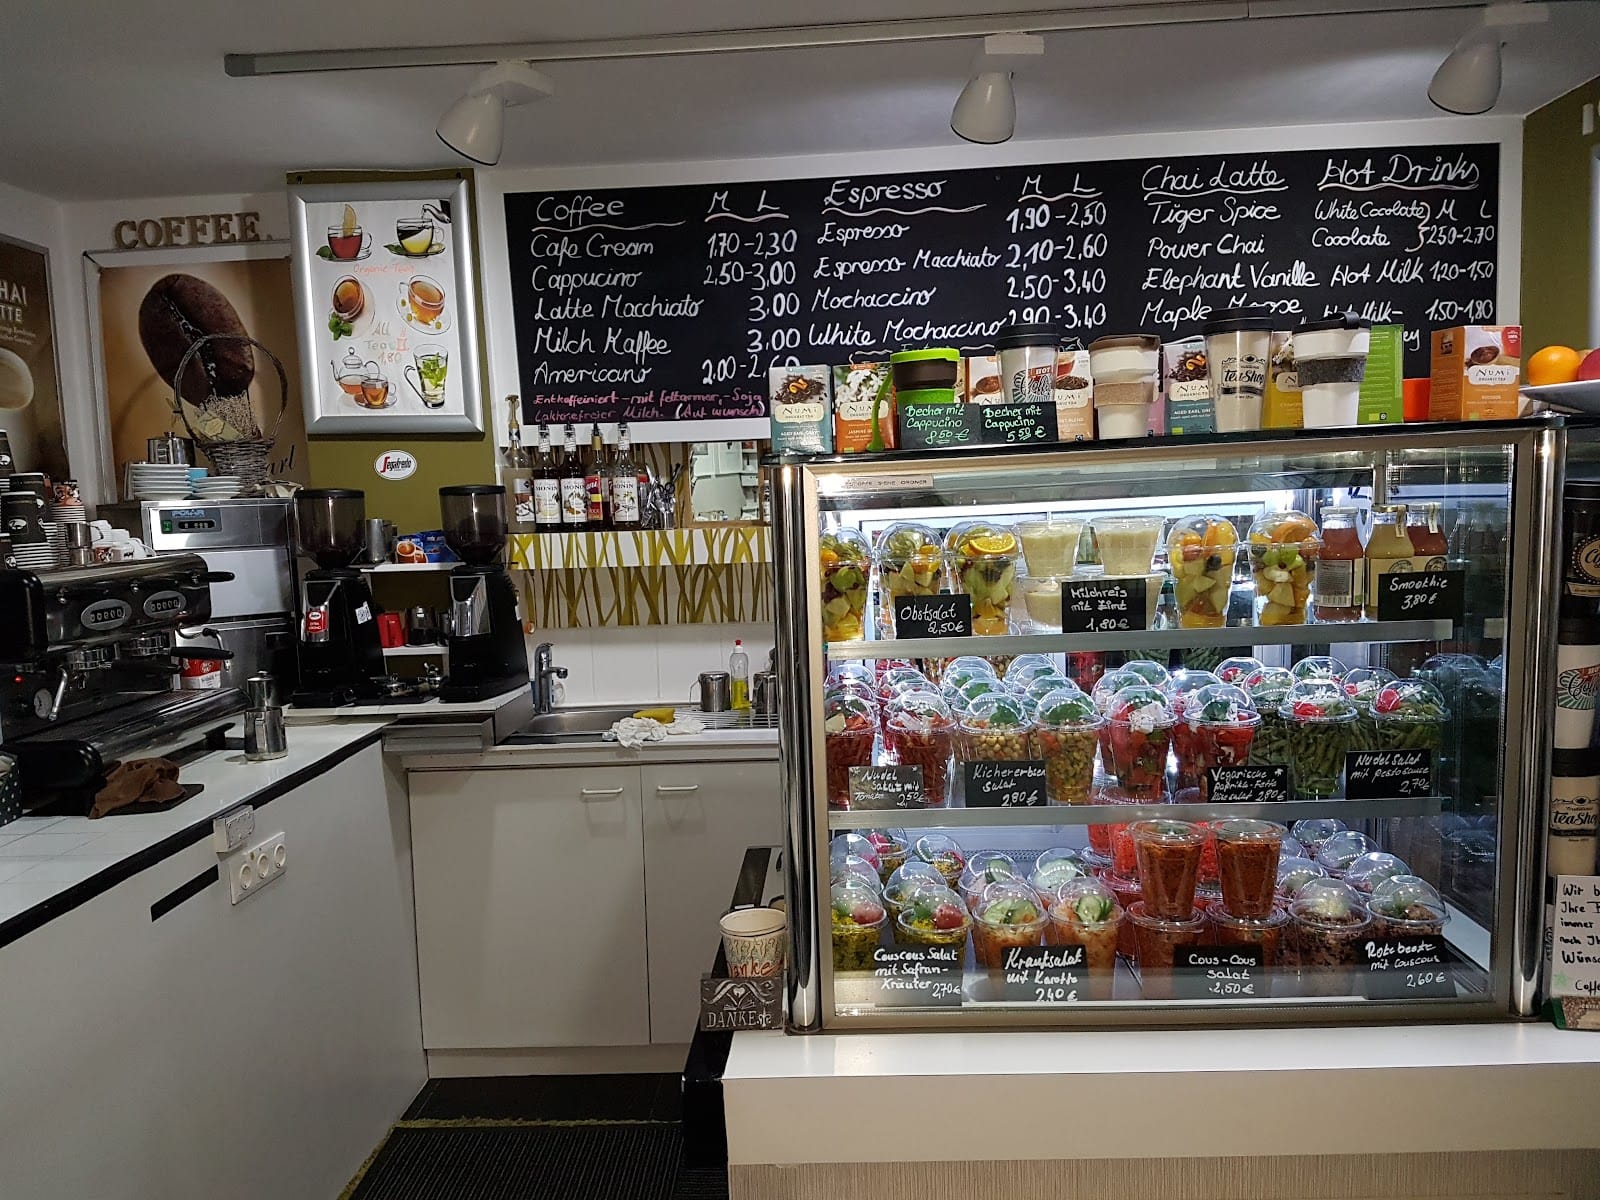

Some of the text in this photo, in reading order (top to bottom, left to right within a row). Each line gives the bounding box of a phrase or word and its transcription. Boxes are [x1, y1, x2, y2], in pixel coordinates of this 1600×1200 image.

[1142, 160, 1286, 191] Chai Latte
[1317, 152, 1480, 186] Hot Drinks
[824, 180, 947, 210] Espresso
[1022, 173, 1096, 195] M L
[536, 195, 624, 227] Coffee
[708, 190, 780, 213] M L
[1315, 198, 1359, 220] White
[1436, 199, 1492, 221] M L
[1147, 196, 1281, 234] Tiger Spice
[817, 222, 910, 247] Espresso
[1147, 233, 1265, 259] Power Chai
[530, 233, 654, 266] Cafe Cream
[813, 246, 1001, 280] Espresso Macchiato
[1330, 256, 1424, 287] Hot Milk
[1141, 260, 1321, 295] Elephant Vanille
[534, 294, 705, 320] Latte Macchiato
[749, 293, 800, 321] 3,00
[811, 286, 936, 312] Mochaccino
[1140, 294, 1213, 331] Maple
[747, 328, 800, 352] 3,00
[808, 317, 1007, 346] White Mochaccino
[533, 327, 672, 365] Milch Kaffee
[534, 361, 652, 385] Americano
[1177, 384, 1209, 392] NUM
[905, 403, 965, 416] Becher mit
[1026, 405, 1042, 416] mit
[906, 417, 963, 431] Cappucino
[985, 416, 1035, 431] Cappucino
[1070, 586, 1128, 599] Milchreis
[900, 603, 957, 621] Obstsalat
[1071, 601, 1093, 612] mit
[874, 948, 925, 961] Couscous
[1370, 959, 1390, 971] mit
[875, 963, 898, 976] mit
[1006, 969, 1028, 984] mit
[707, 1011, 757, 1027] DANKE
